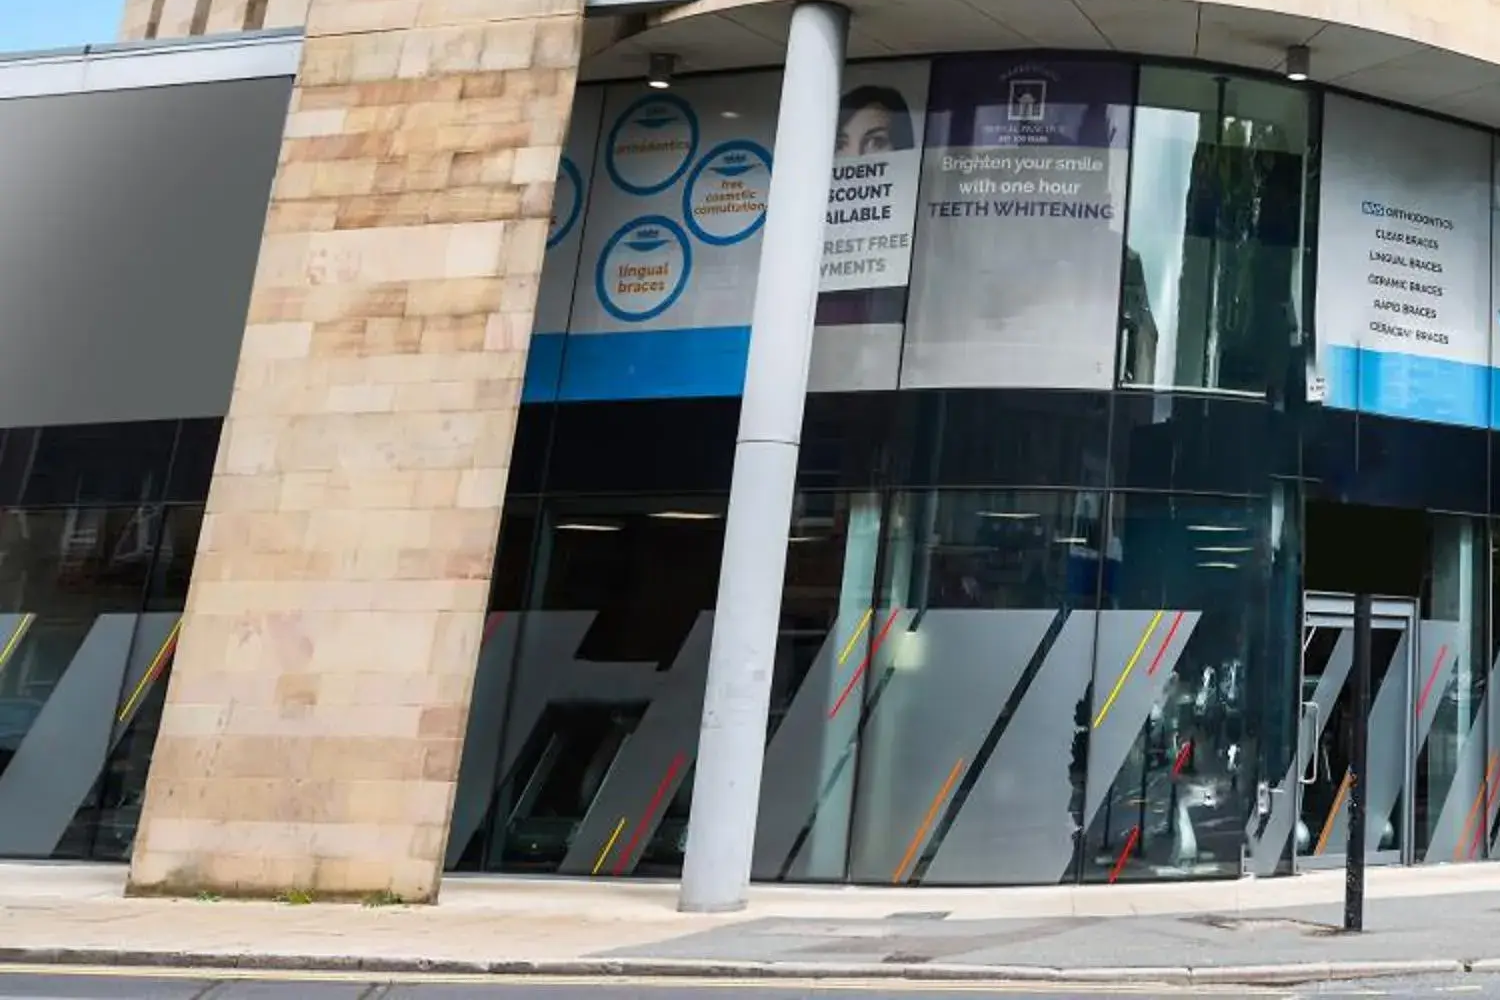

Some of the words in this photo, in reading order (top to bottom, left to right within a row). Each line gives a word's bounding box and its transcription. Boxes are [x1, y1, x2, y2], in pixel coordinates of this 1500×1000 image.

[832, 162, 890, 180] UDENT
[942, 155, 1011, 175] Brighten
[1014, 158, 1052, 175] your
[1055, 155, 1103, 172] smile
[828, 183, 893, 203] SCOUNT
[959, 178, 995, 195] with
[1001, 181, 1036, 194] one
[1038, 178, 1082, 195] hour
[826, 205, 892, 225] AILABLE
[928, 201, 989, 218] TEETH
[994, 201, 1115, 219] WHITENING
[823, 237, 866, 256] REST
[868, 233, 910, 251] FREE
[618, 262, 669, 281] lingual
[820, 257, 887, 278] YMENTS
[617, 280, 665, 294] braces
[1401, 303, 1437, 319] BRACES
